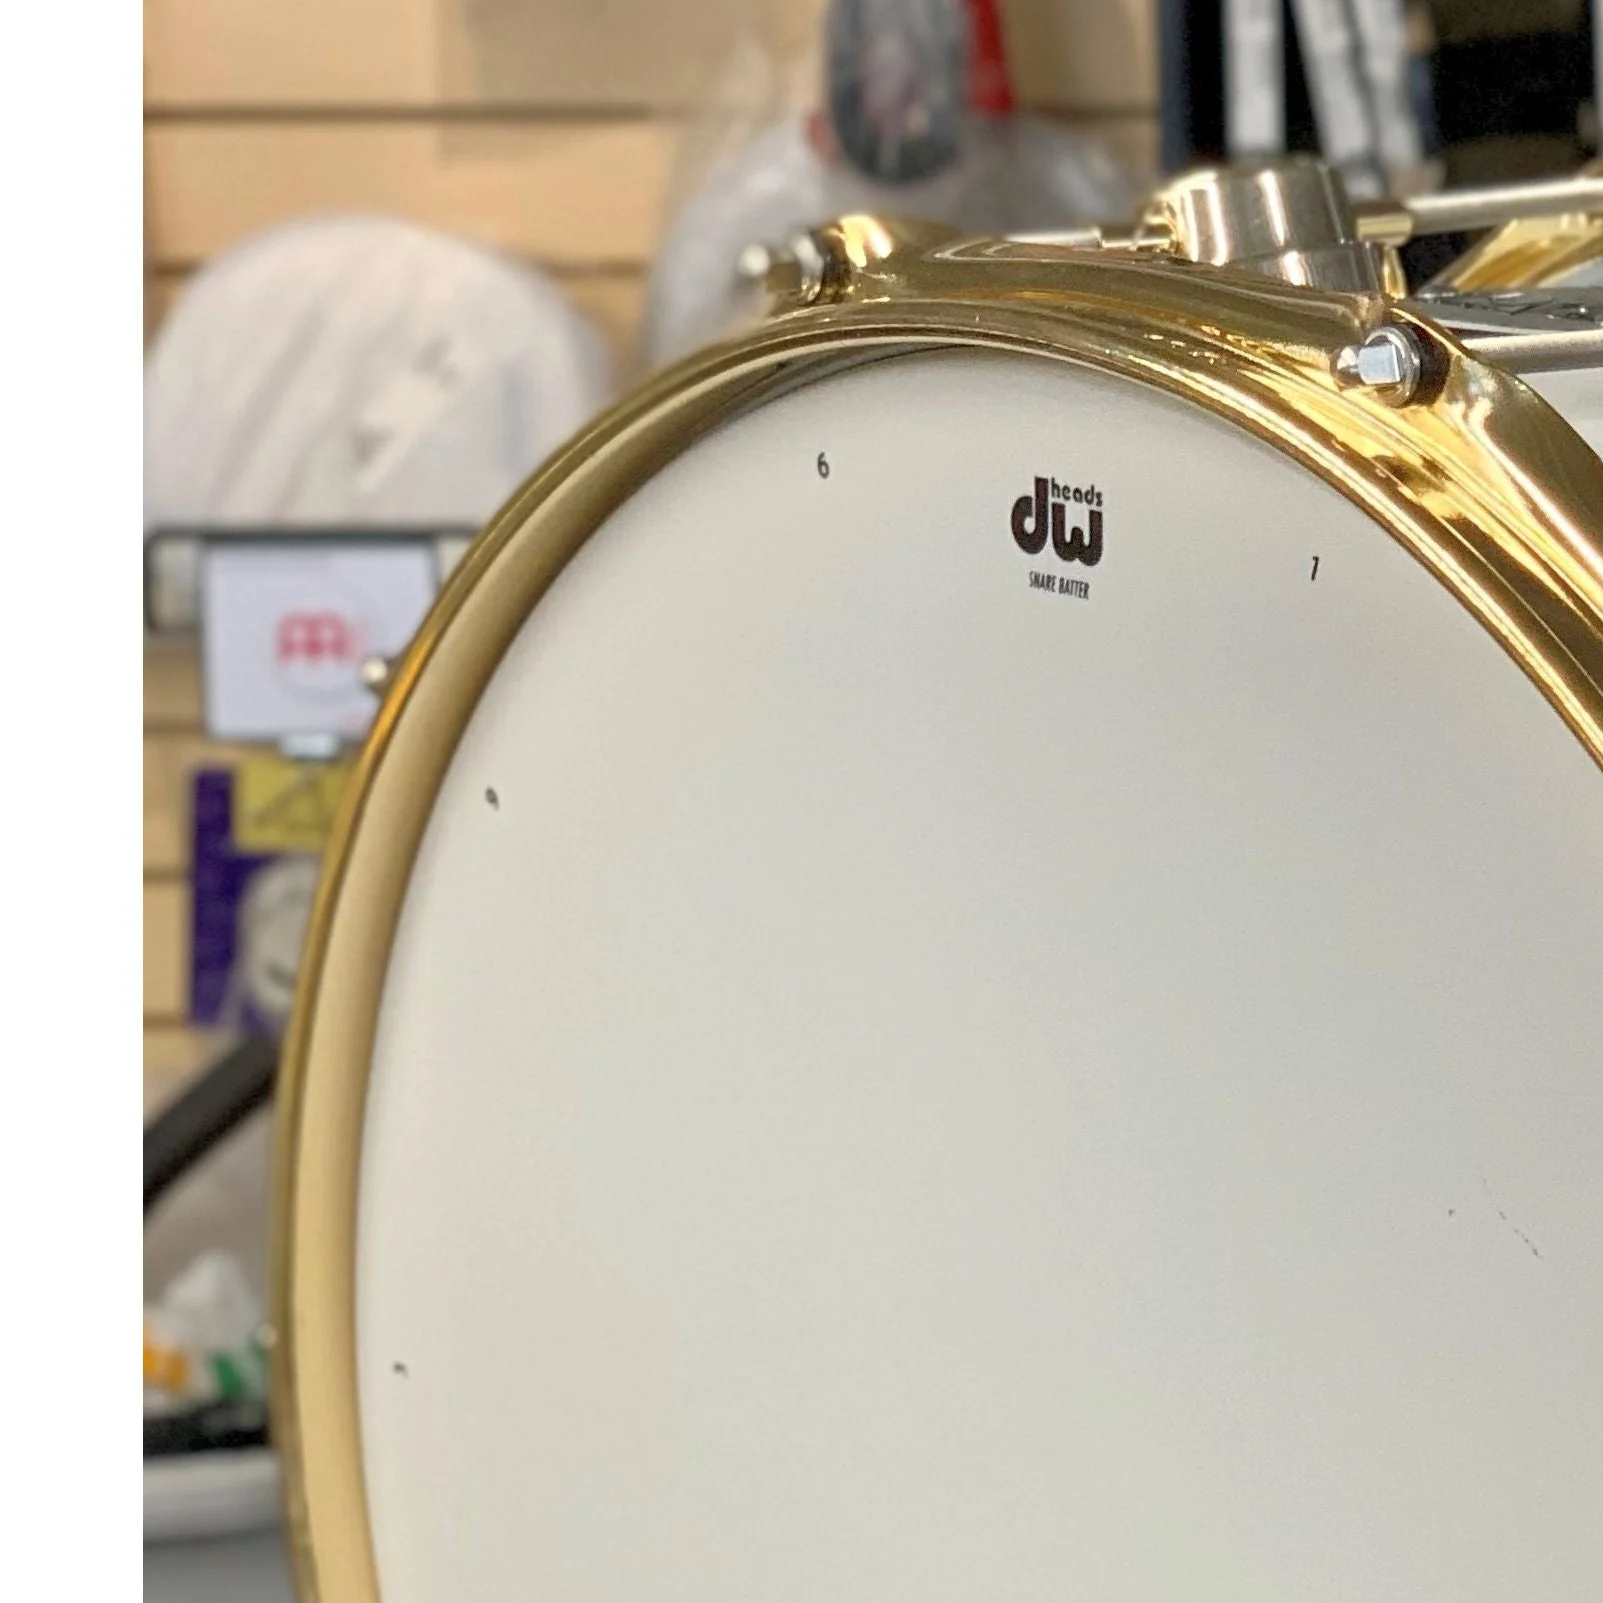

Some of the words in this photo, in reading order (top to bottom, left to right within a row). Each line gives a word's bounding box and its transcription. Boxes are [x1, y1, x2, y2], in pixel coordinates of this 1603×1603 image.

[816, 451, 830, 480] 6
[1051, 477, 1103, 507] heads
[1010, 476, 1103, 567] dw
[1310, 555, 1321, 582] 1
[1028, 570, 1057, 593] SNARE
[1058, 577, 1090, 600] BATTER
